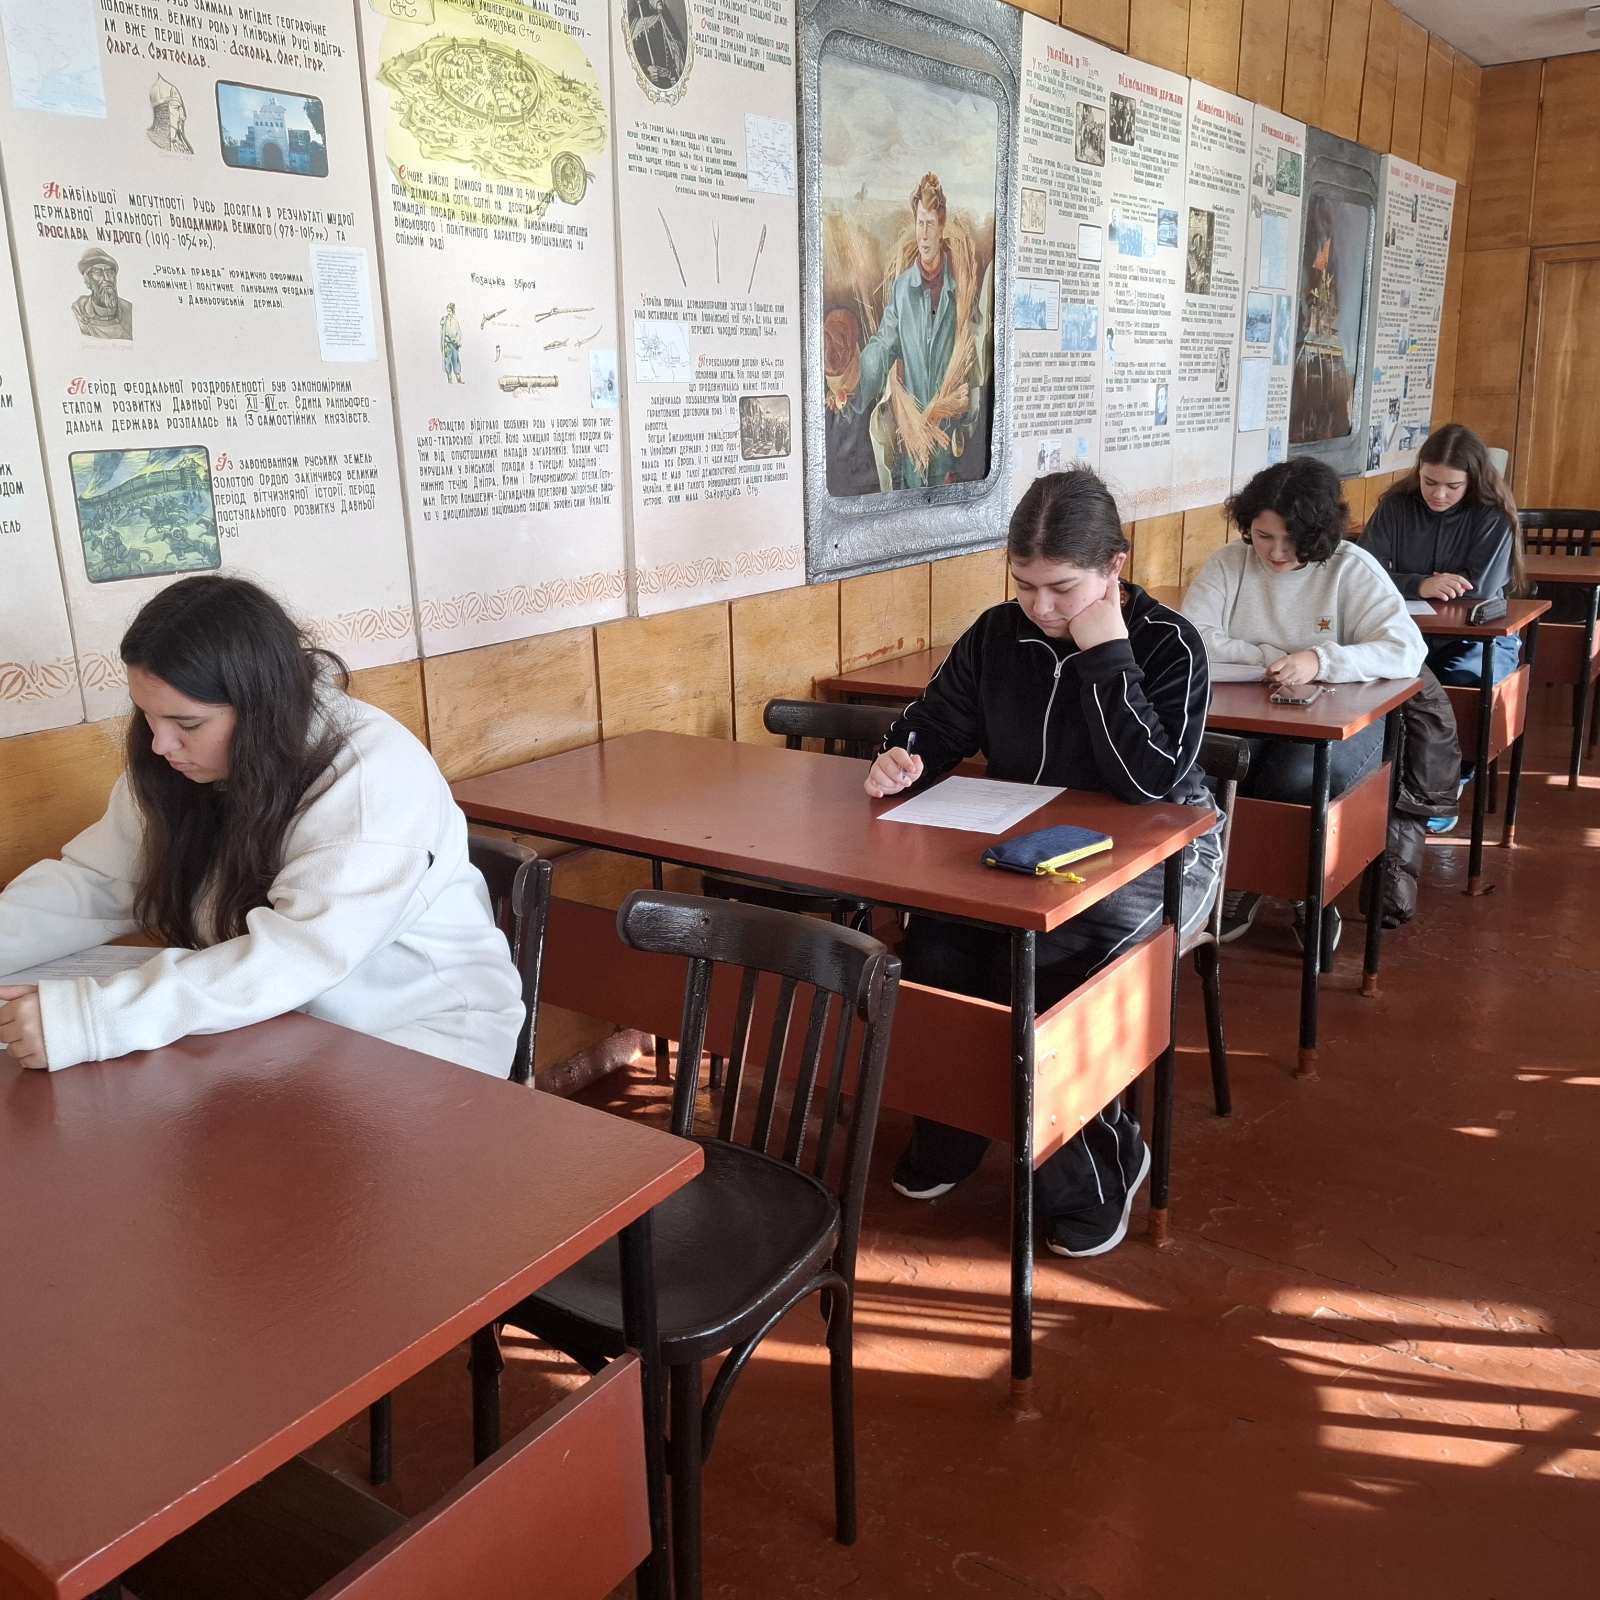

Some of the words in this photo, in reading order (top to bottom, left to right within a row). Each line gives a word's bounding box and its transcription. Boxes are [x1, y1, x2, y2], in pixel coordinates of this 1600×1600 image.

[105, 17, 116, 32] ЛИ
[125, 21, 146, 38] ВЖЕ
[155, 27, 185, 45] ПЕРШІ
[168, 9, 202, 29] ВЕЛИКУ
[209, 19, 229, 34] РОЛЬ
[233, 24, 238, 35] У
[243, 24, 286, 46] КИЇВСЬКІЙ
[292, 34, 310, 50] РУСІ
[239, 7, 272, 25] ВИГІДНЕ
[276, 16, 327, 36] ГЕОГРАФІЧНЕ
[43, 181, 117, 204] НАЙБІЛЬШОЇ
[129, 193, 185, 211] МОГУТНОСТІ
[193, 197, 216, 213] РУСЬ
[224, 202, 262, 219] ДОСЯГЛА
[267, 207, 271, 218] В
[277, 207, 323, 224] РЕЗУЛЬТАТІ
[327, 212, 355, 227] МУДРОЇ
[442, 192, 449, 203] НА
[33, 204, 94, 222] ДЕРЖАВНОЇ
[105, 208, 162, 227] ДІЯЛЬНОСТІ
[170, 214, 228, 233] ВОЛОДИМИРА
[232, 219, 272, 236] ВЕЛИКОГО
[337, 230, 346, 242] ТА
[394, 214, 435, 232] ВІЙСЬКОВОГО
[447, 222, 488, 239] ПОЛІТИЧНОГО
[431, 206, 455, 221] ПОСАДИ
[461, 211, 476, 223] БУЛИ
[37, 222, 89, 241] ЯРОСЛАВА
[96, 227, 141, 245] МУДРОГО
[142, 278, 187, 290] ЕКОНОМІЧНЕ
[196, 281, 234, 293] ПОЛІТИЧНЕ
[67, 376, 117, 397] ПЕРІОД
[124, 379, 184, 396] ФЕОДАЛЬНОЇ
[192, 378, 265, 395] РОЗДРОБЛЕНОСТІ
[272, 381, 287, 393] БУВ
[292, 377, 352, 393] ЗАКОНОМІРНИМ
[62, 402, 102, 415] ЕТАПОМ
[113, 400, 162, 413] РОЗВИТКУ
[173, 396, 212, 413] ДАВНЬОЇ
[217, 395, 238, 410] РУСІ
[295, 395, 322, 410] ЄДИНА
[66, 419, 103, 435] ДАЛЬНА
[112, 418, 159, 432] ДЕРЖАВА
[167, 416, 218, 429] РОЗПАЛАСЬ
[226, 416, 238, 427] НА
[245, 414, 254, 426] 13
[257, 411, 317, 426] САМОСТІЙНИХ
[324, 412, 370, 424] КНЯЗІВСТВ.
[239, 456, 299, 470] ЗАВОЮВАННЯМ
[304, 454, 338, 467] РУСЬКИХ
[344, 453, 373, 464] ЗЕМЕЛЬ
[213, 475, 254, 489] ЗОЛОТОЮ
[259, 473, 289, 487] ОРДОЮ
[295, 469, 342, 483] ЗАКІНЧИВСЯ
[347, 465, 378, 480] ВЕЛИКИЙ
[215, 491, 247, 505] ПЕРІОД
[253, 486, 309, 503] ВІТЧИЗНЯНОЇ
[349, 481, 376, 495] ПЕРІОД
[217, 506, 287, 522] ПОСТУПАЛЬНОГО
[294, 502, 335, 516] РОЗВИТКУ
[341, 497, 375, 513] ДАВНЬОЇ
[219, 523, 239, 538] РУСІ
